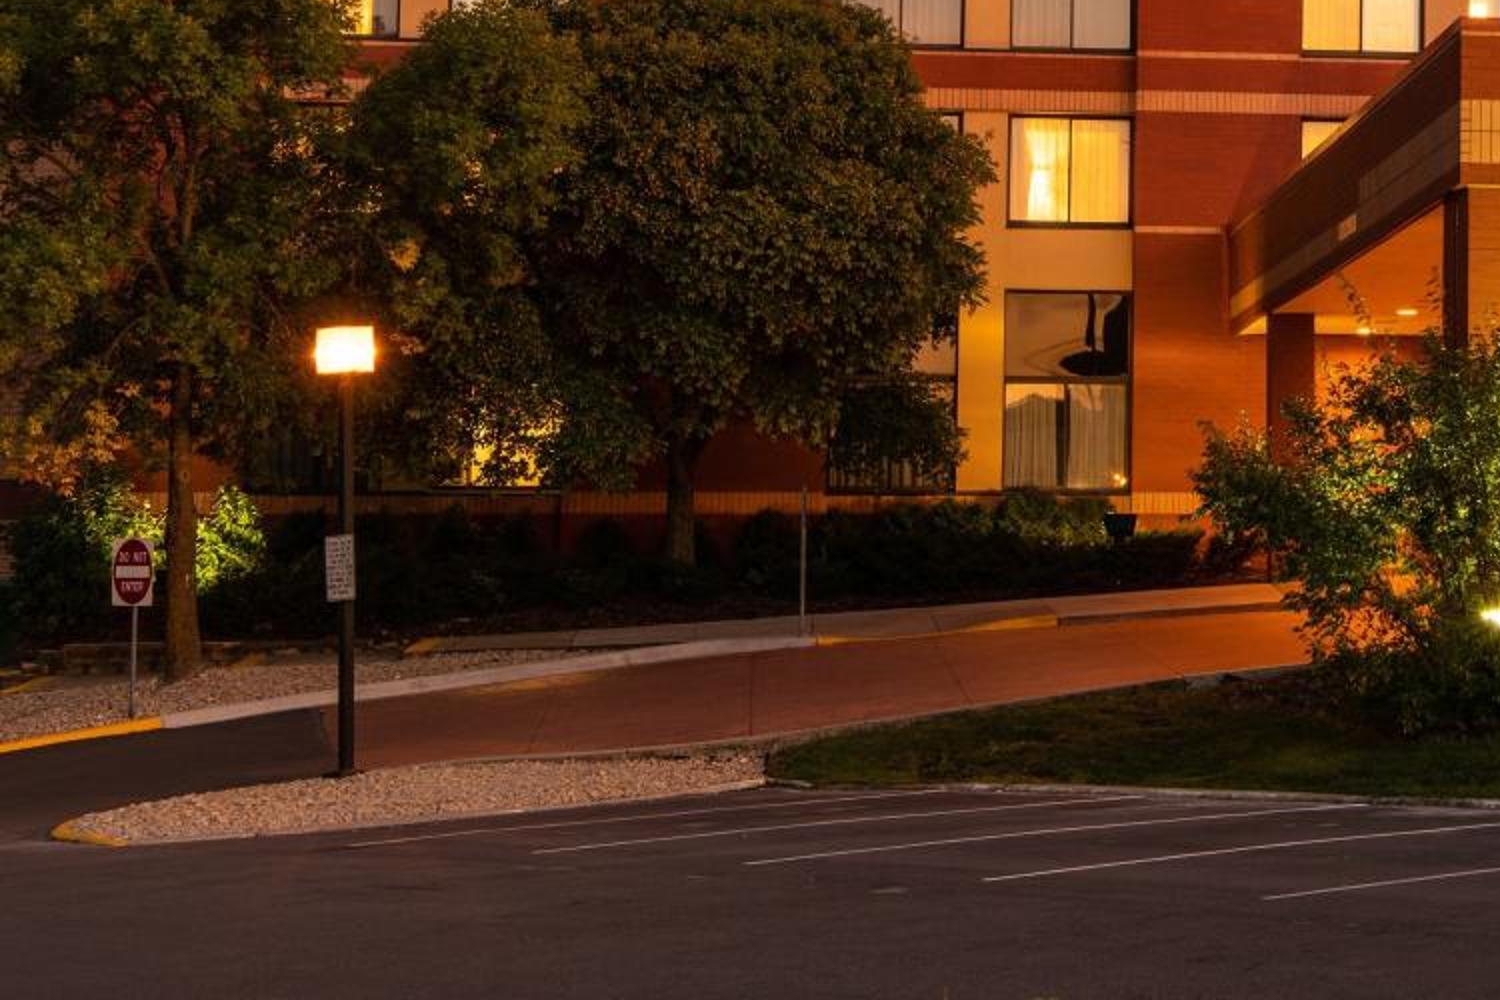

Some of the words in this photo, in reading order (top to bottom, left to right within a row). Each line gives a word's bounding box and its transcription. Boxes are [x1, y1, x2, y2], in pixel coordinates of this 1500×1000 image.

[119, 551, 129, 563] DO
[133, 551, 147, 563] NOT
[120, 581, 144, 593] ENTER
